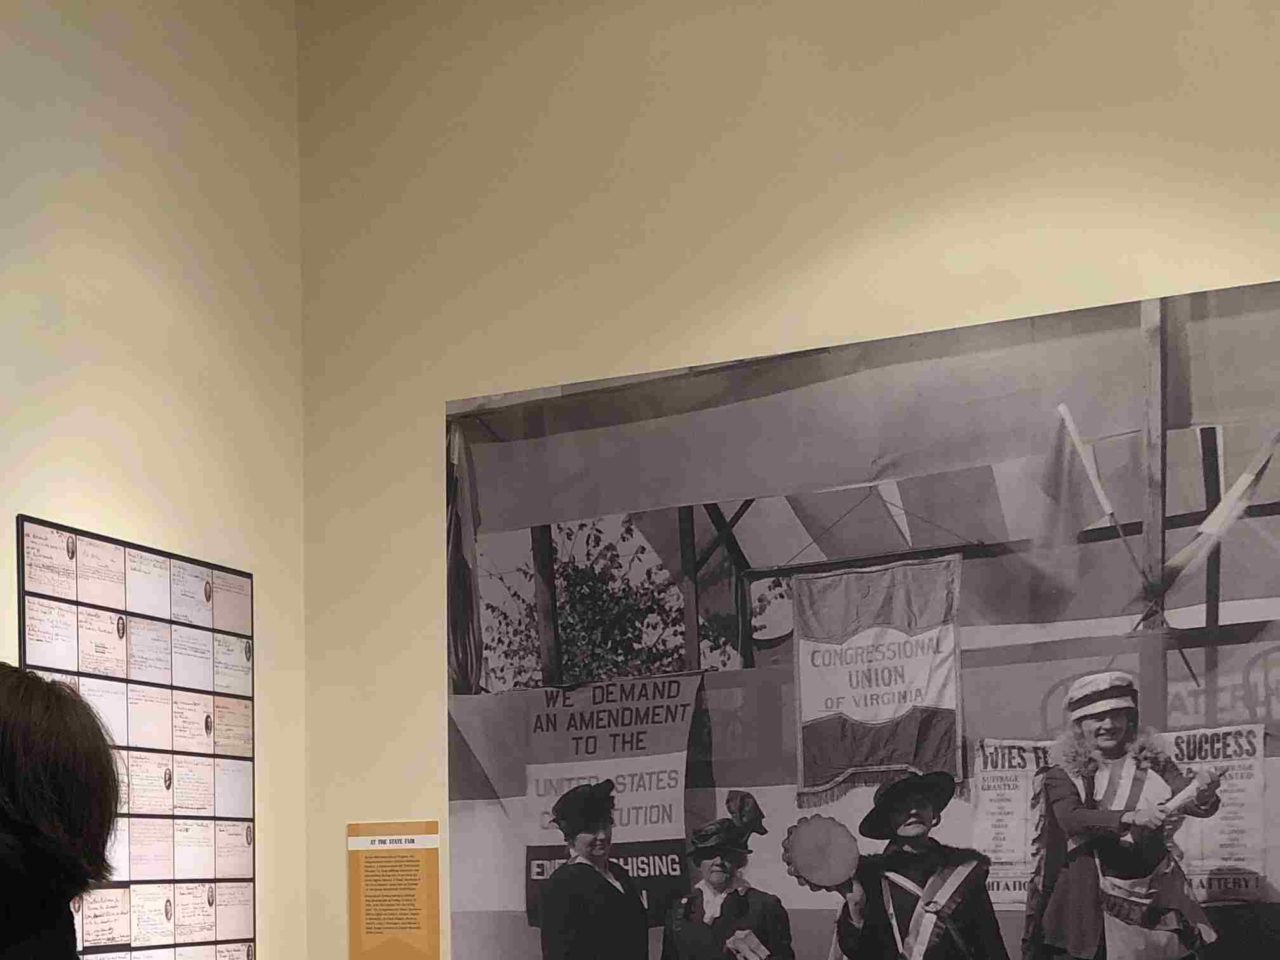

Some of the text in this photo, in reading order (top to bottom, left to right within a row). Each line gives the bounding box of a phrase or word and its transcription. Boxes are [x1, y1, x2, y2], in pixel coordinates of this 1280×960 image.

[810, 636, 942, 668] CONGRESSIONAL
[848, 665, 906, 690] UNION
[544, 680, 681, 708] WE DEMAND
[824, 688, 924, 710] OF VIRGINIA
[533, 703, 690, 733] AN AMENDMENT
[572, 731, 647, 755] TO THE
[1174, 730, 1257, 761] SUCCESS
[615, 769, 679, 794] STATES
